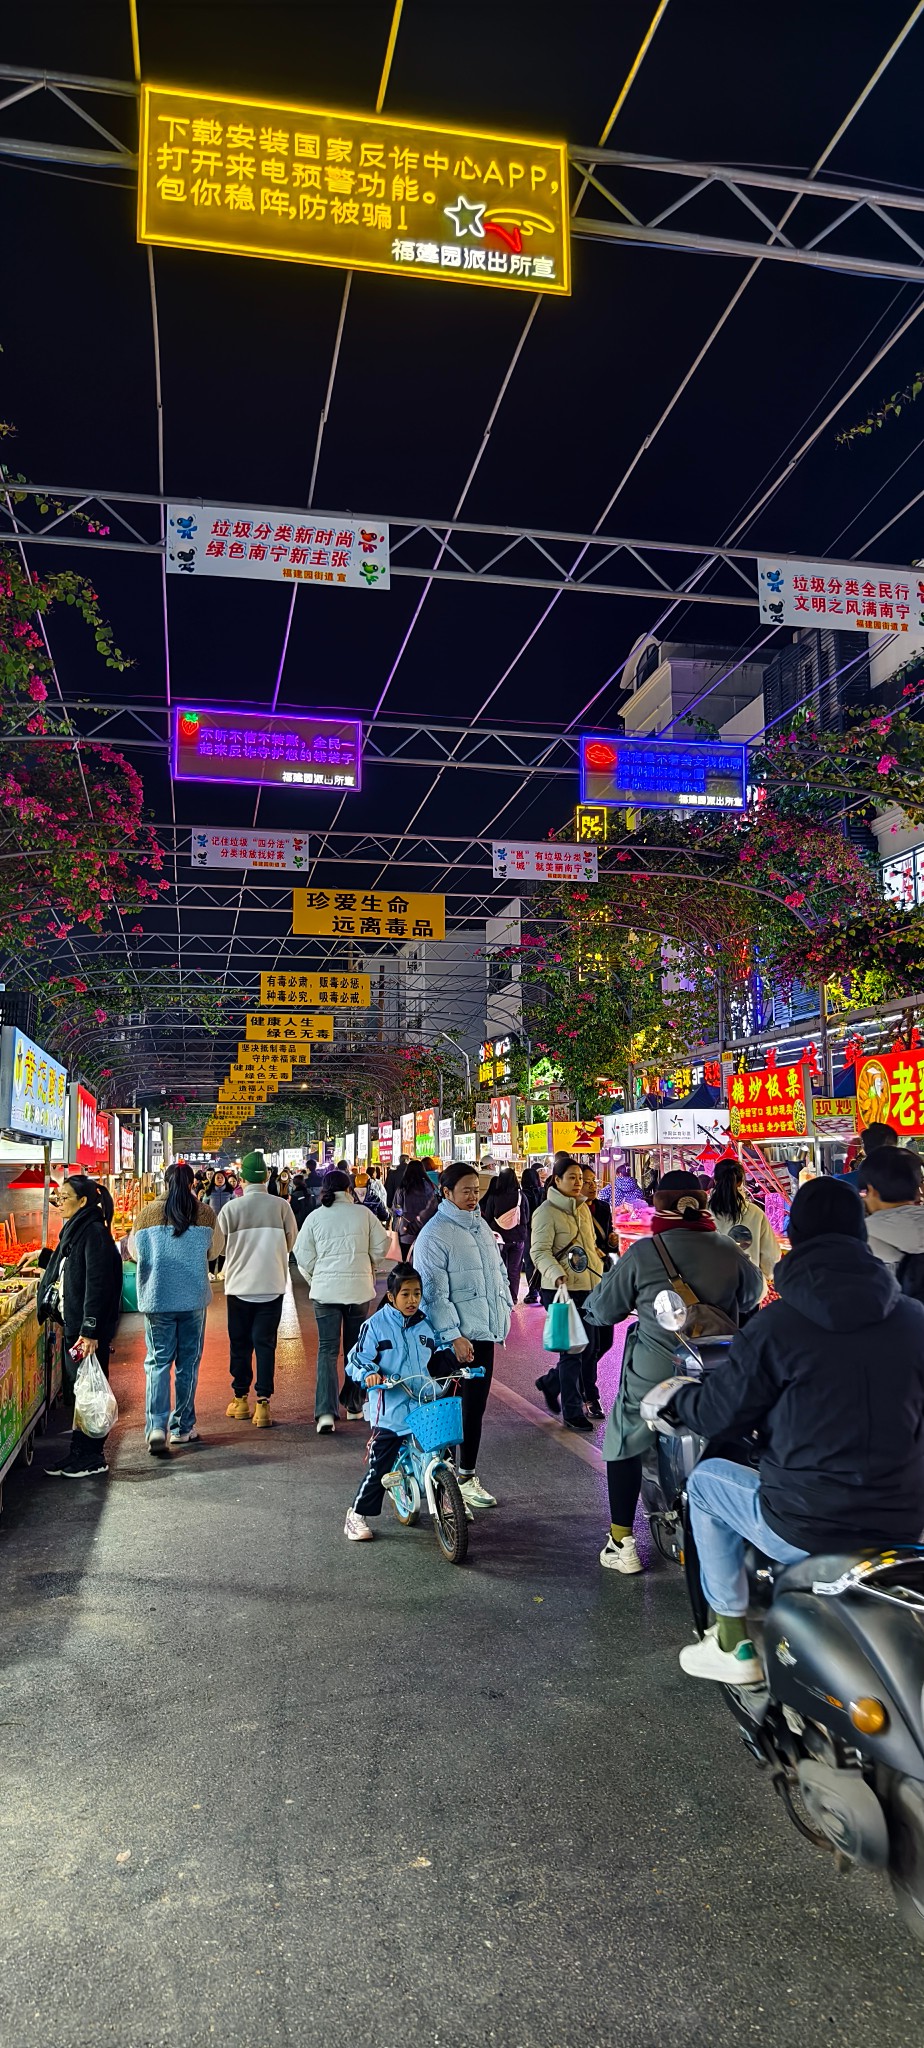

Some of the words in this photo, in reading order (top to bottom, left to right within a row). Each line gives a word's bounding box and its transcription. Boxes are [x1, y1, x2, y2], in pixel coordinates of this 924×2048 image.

[156, 142, 437, 205] 打开来电预警功能。
[391, 239, 556, 280] 福建园派出所宣
[210, 519, 355, 548] 垃圾分类新时尚
[205, 540, 351, 568] 绿色南宁新主张
[282, 568, 334, 582] 福建园街道
[336, 572, 347, 582] 宣
[793, 574, 910, 601] 垃圾分类全民行
[794, 595, 910, 620] 文明之风满南宁
[856, 618, 899, 632] 福建园街道
[900, 623, 909, 632] 宣
[199, 741, 355, 765] 起来反诈守护您的钱袋子
[220, 848, 285, 860] 分类投放找好家
[306, 891, 410, 915] 珍爱生命
[331, 915, 434, 937] 远离毒品
[250, 1016, 315, 1027] 健康人生
[266, 1028, 331, 1039] 绿色无毒
[241, 1044, 297, 1053] 坚决抵制毒品
[252, 1054, 307, 1063] 守护幸福家庭
[233, 1064, 278, 1072] 健康人生
[731, 1068, 801, 1105] 糖炒板栗
[890, 1059, 924, 1127] 老
[815, 1099, 852, 1116] 现炒
